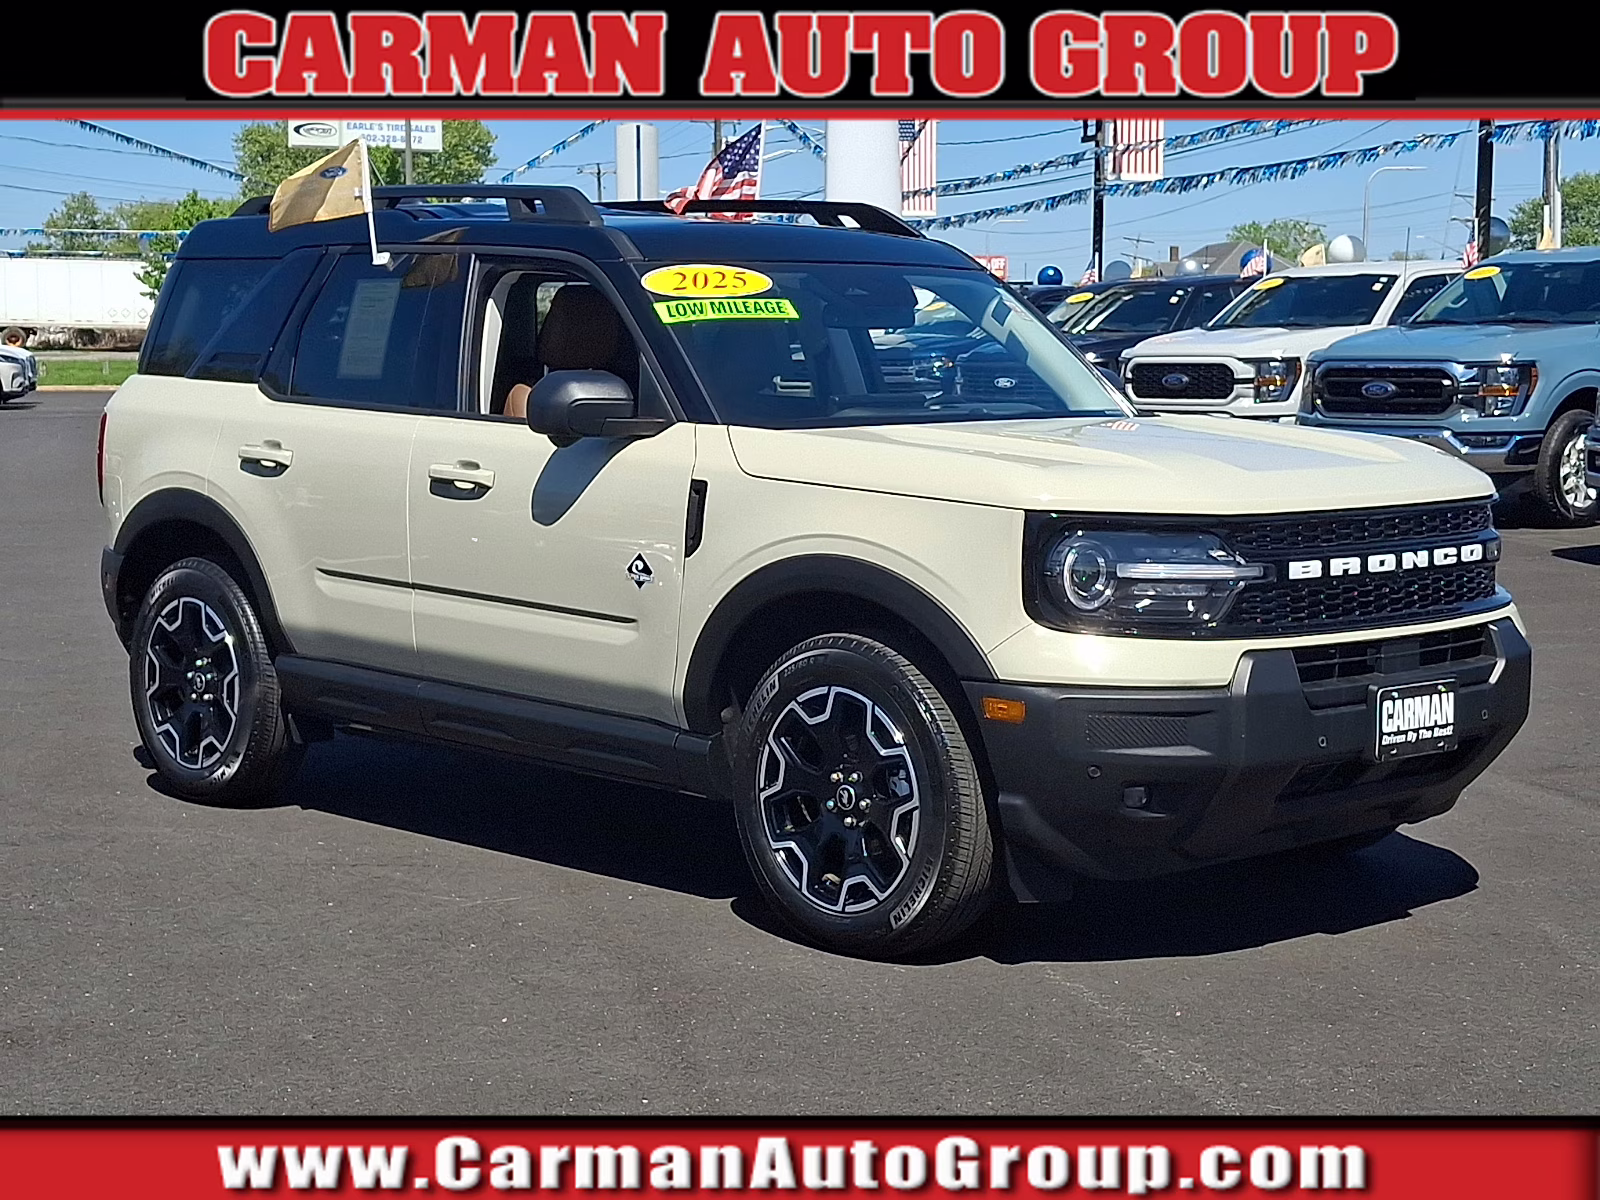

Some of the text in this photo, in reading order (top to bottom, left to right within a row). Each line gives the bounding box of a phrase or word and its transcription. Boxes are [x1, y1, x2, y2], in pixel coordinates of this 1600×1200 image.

[346, 122, 383, 130] EARLE'S
[672, 271, 747, 291] 2025
[666, 300, 789, 318] LOW MILEAGE
[1288, 543, 1483, 580] BRONCO
[1381, 691, 1455, 734] CARMAN
[1381, 733, 1406, 746] Driven
[1406, 730, 1418, 743] By
[1418, 728, 1432, 740] The
